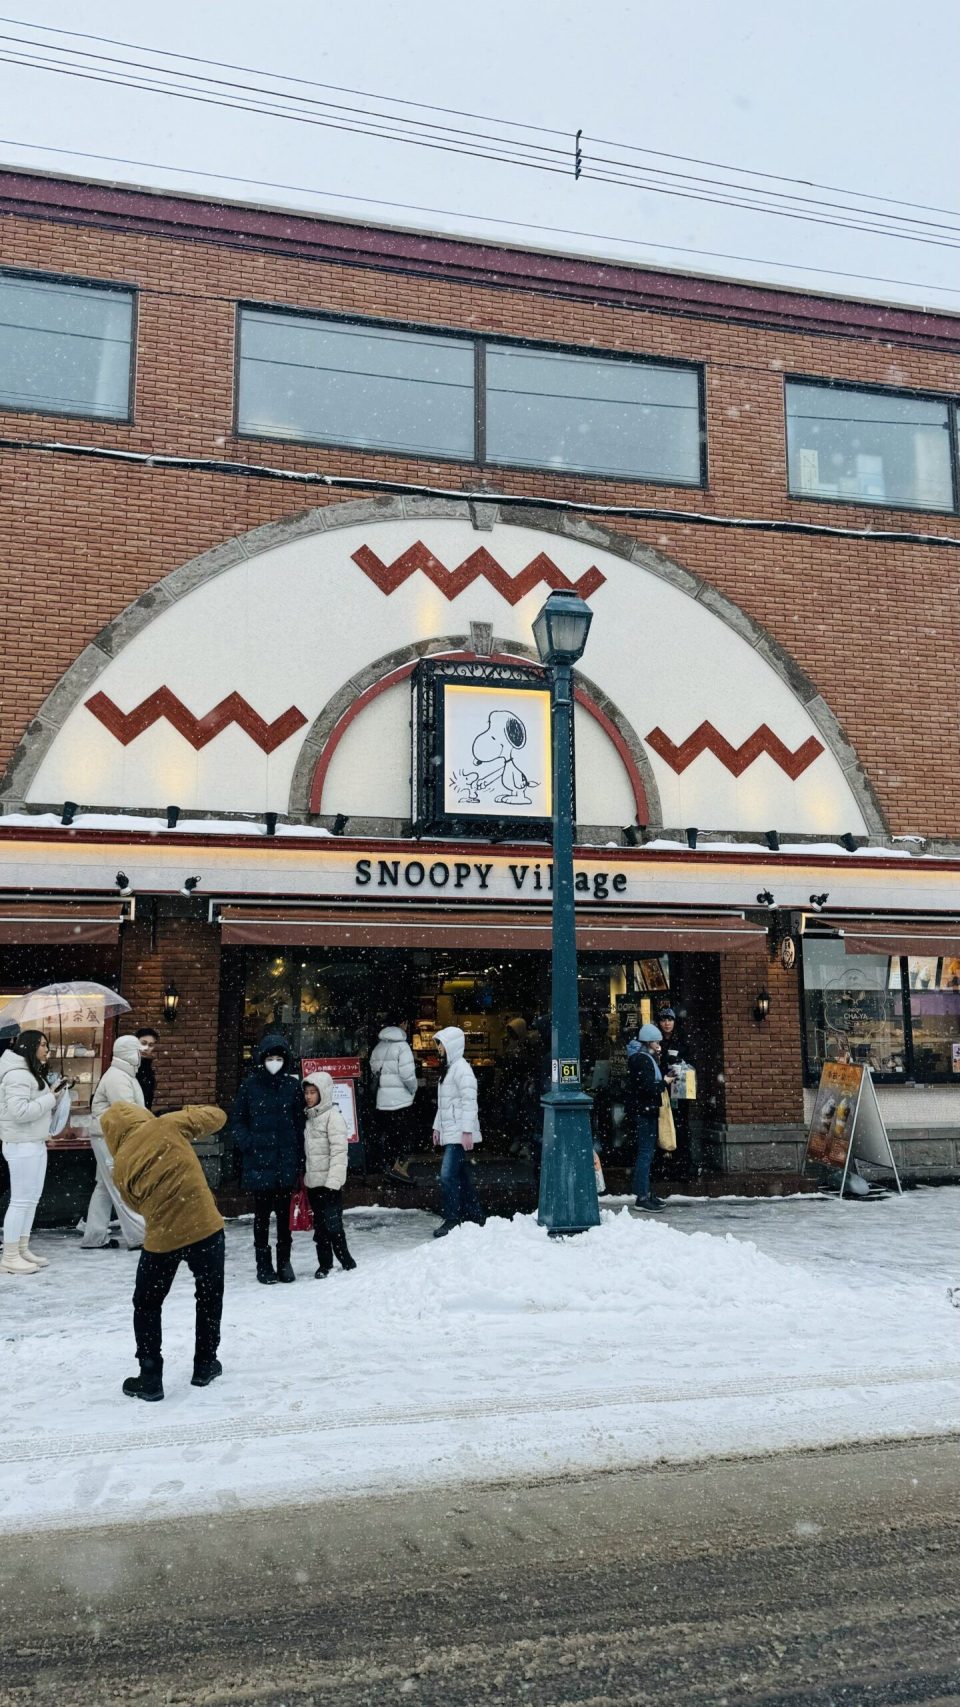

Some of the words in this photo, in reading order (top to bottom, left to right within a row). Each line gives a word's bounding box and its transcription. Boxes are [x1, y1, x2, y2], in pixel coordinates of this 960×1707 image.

[355, 859, 493, 889] SNOOPY
[508, 863, 628, 900] Vilage
[563, 1065, 575, 1076] 61
